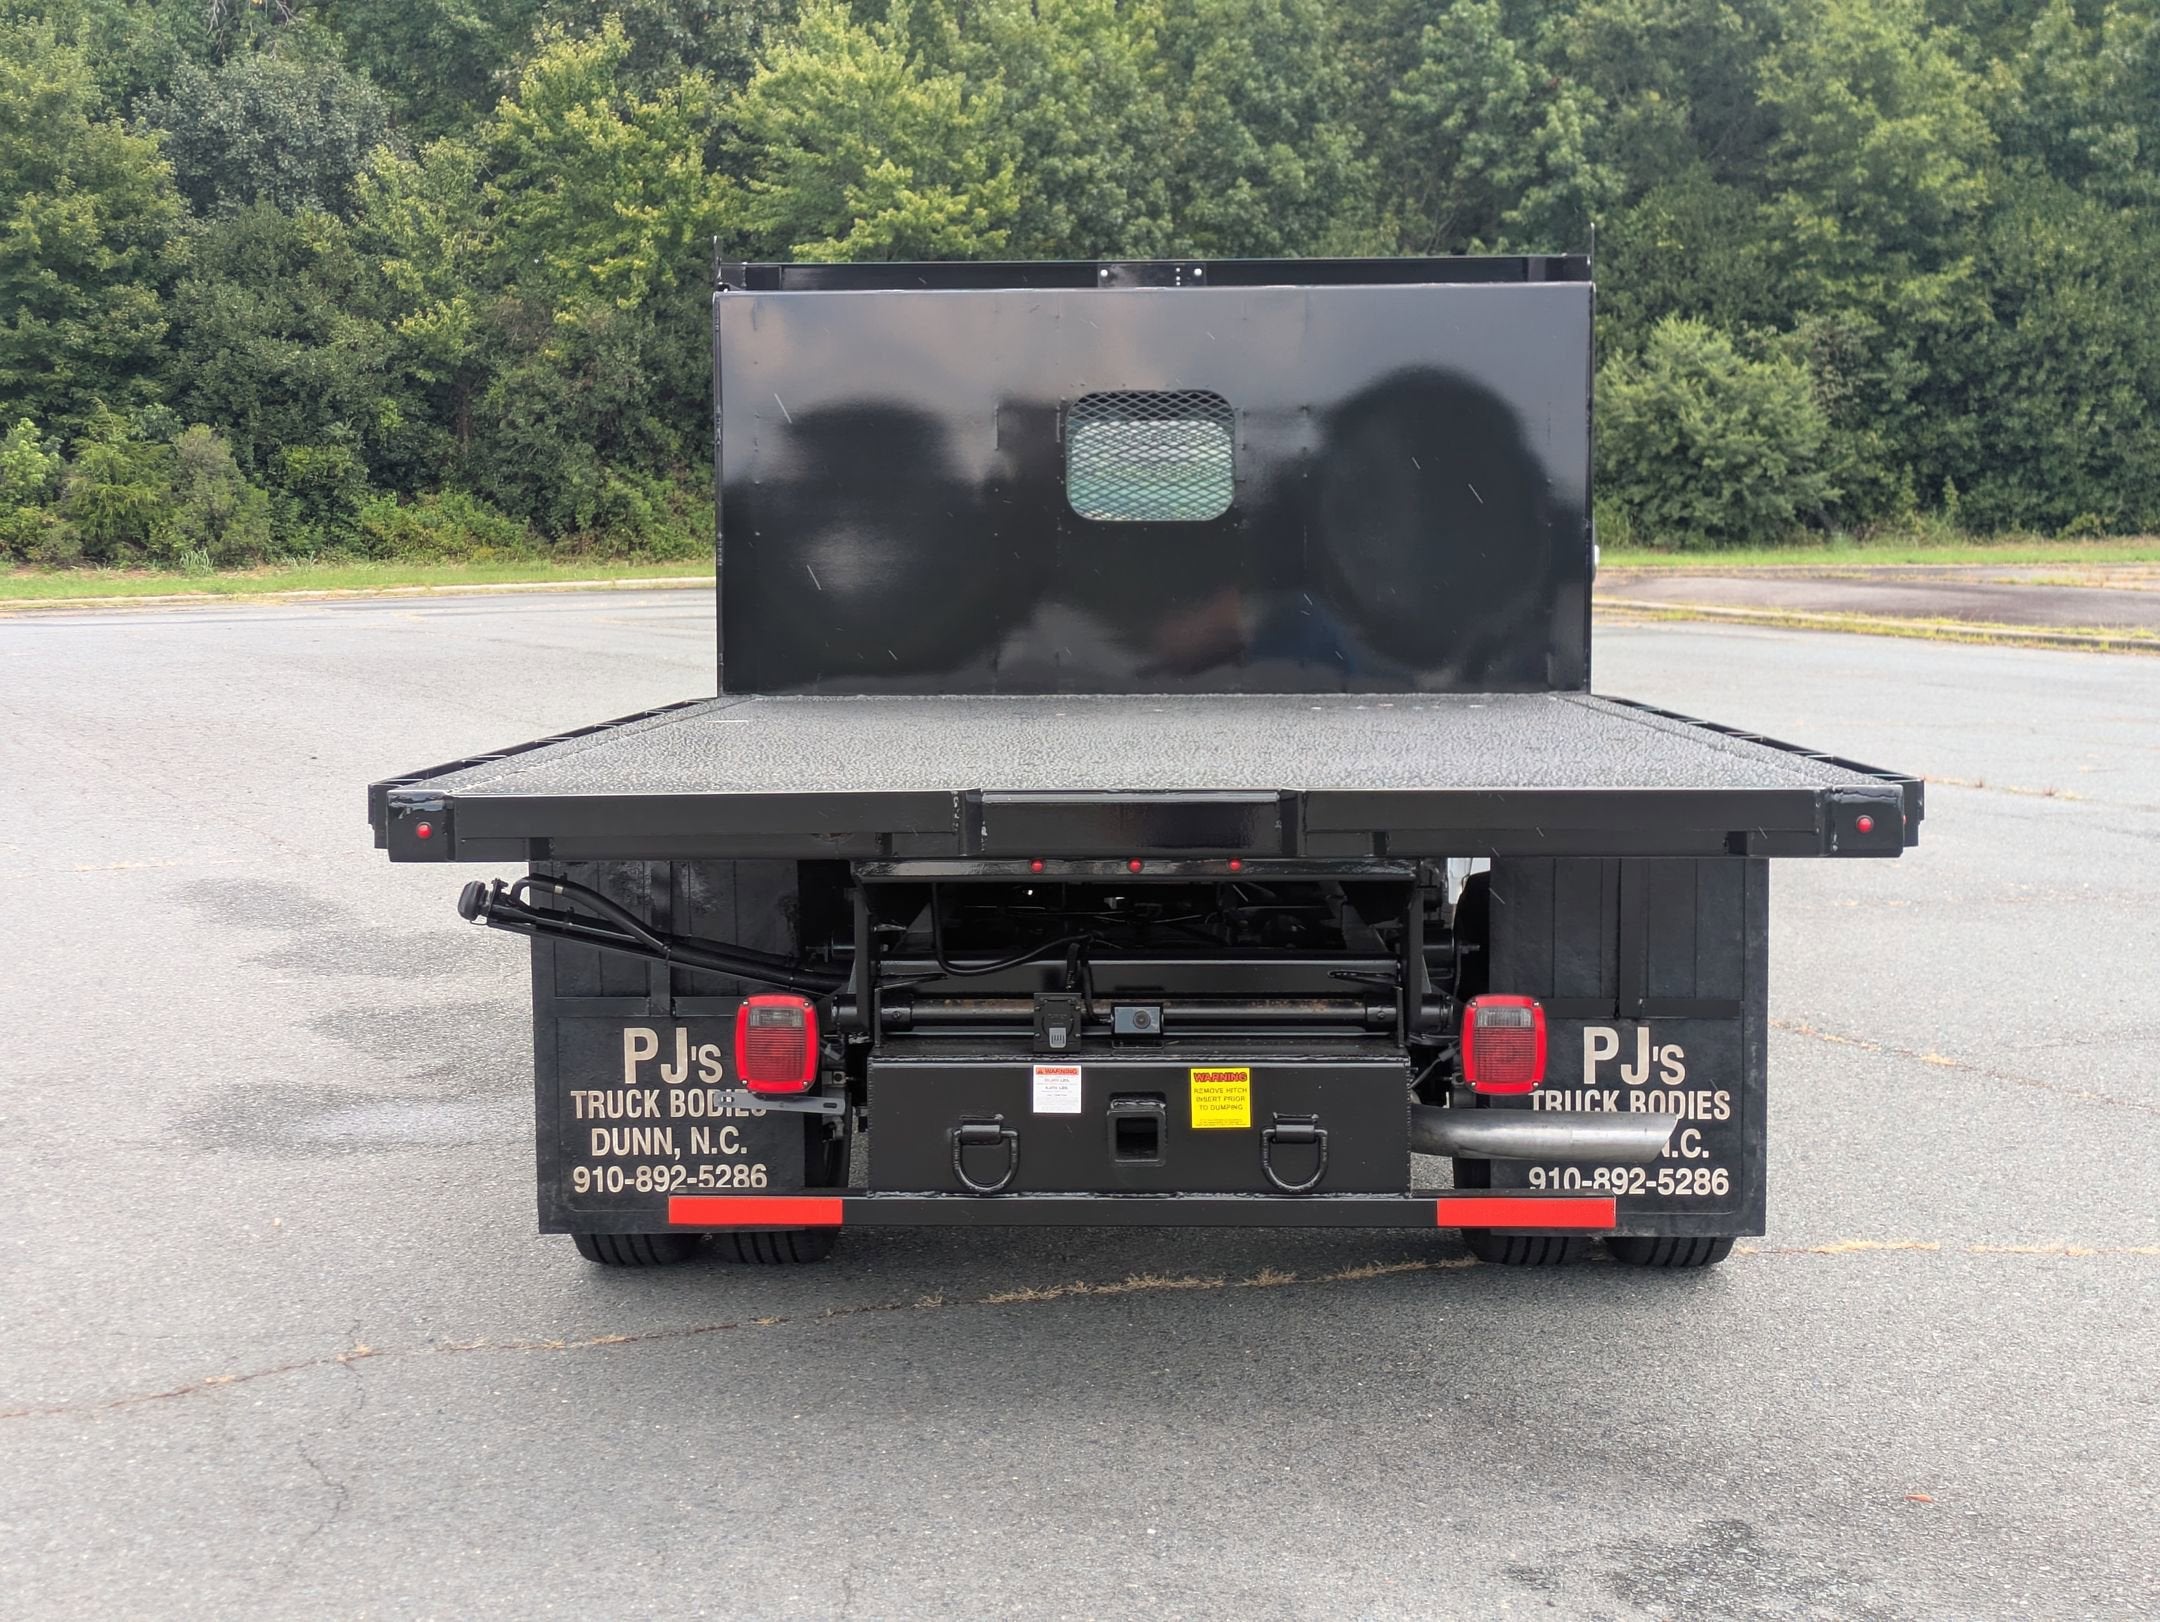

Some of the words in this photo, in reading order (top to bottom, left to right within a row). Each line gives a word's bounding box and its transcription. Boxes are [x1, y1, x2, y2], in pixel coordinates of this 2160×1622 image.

[1044, 1067, 1078, 1075] WARNING
[1193, 1072, 1248, 1083] WARNING
[570, 1089, 661, 1119] TRUCK
[1528, 1089, 1620, 1113] TRUCK
[1630, 1089, 1731, 1120] BODIES
[591, 1127, 680, 1161] DUNN,
[690, 1125, 748, 1155] N.C.
[572, 1163, 768, 1194] 910-892-5286
[1528, 1166, 1730, 1196] 910-892-5286
